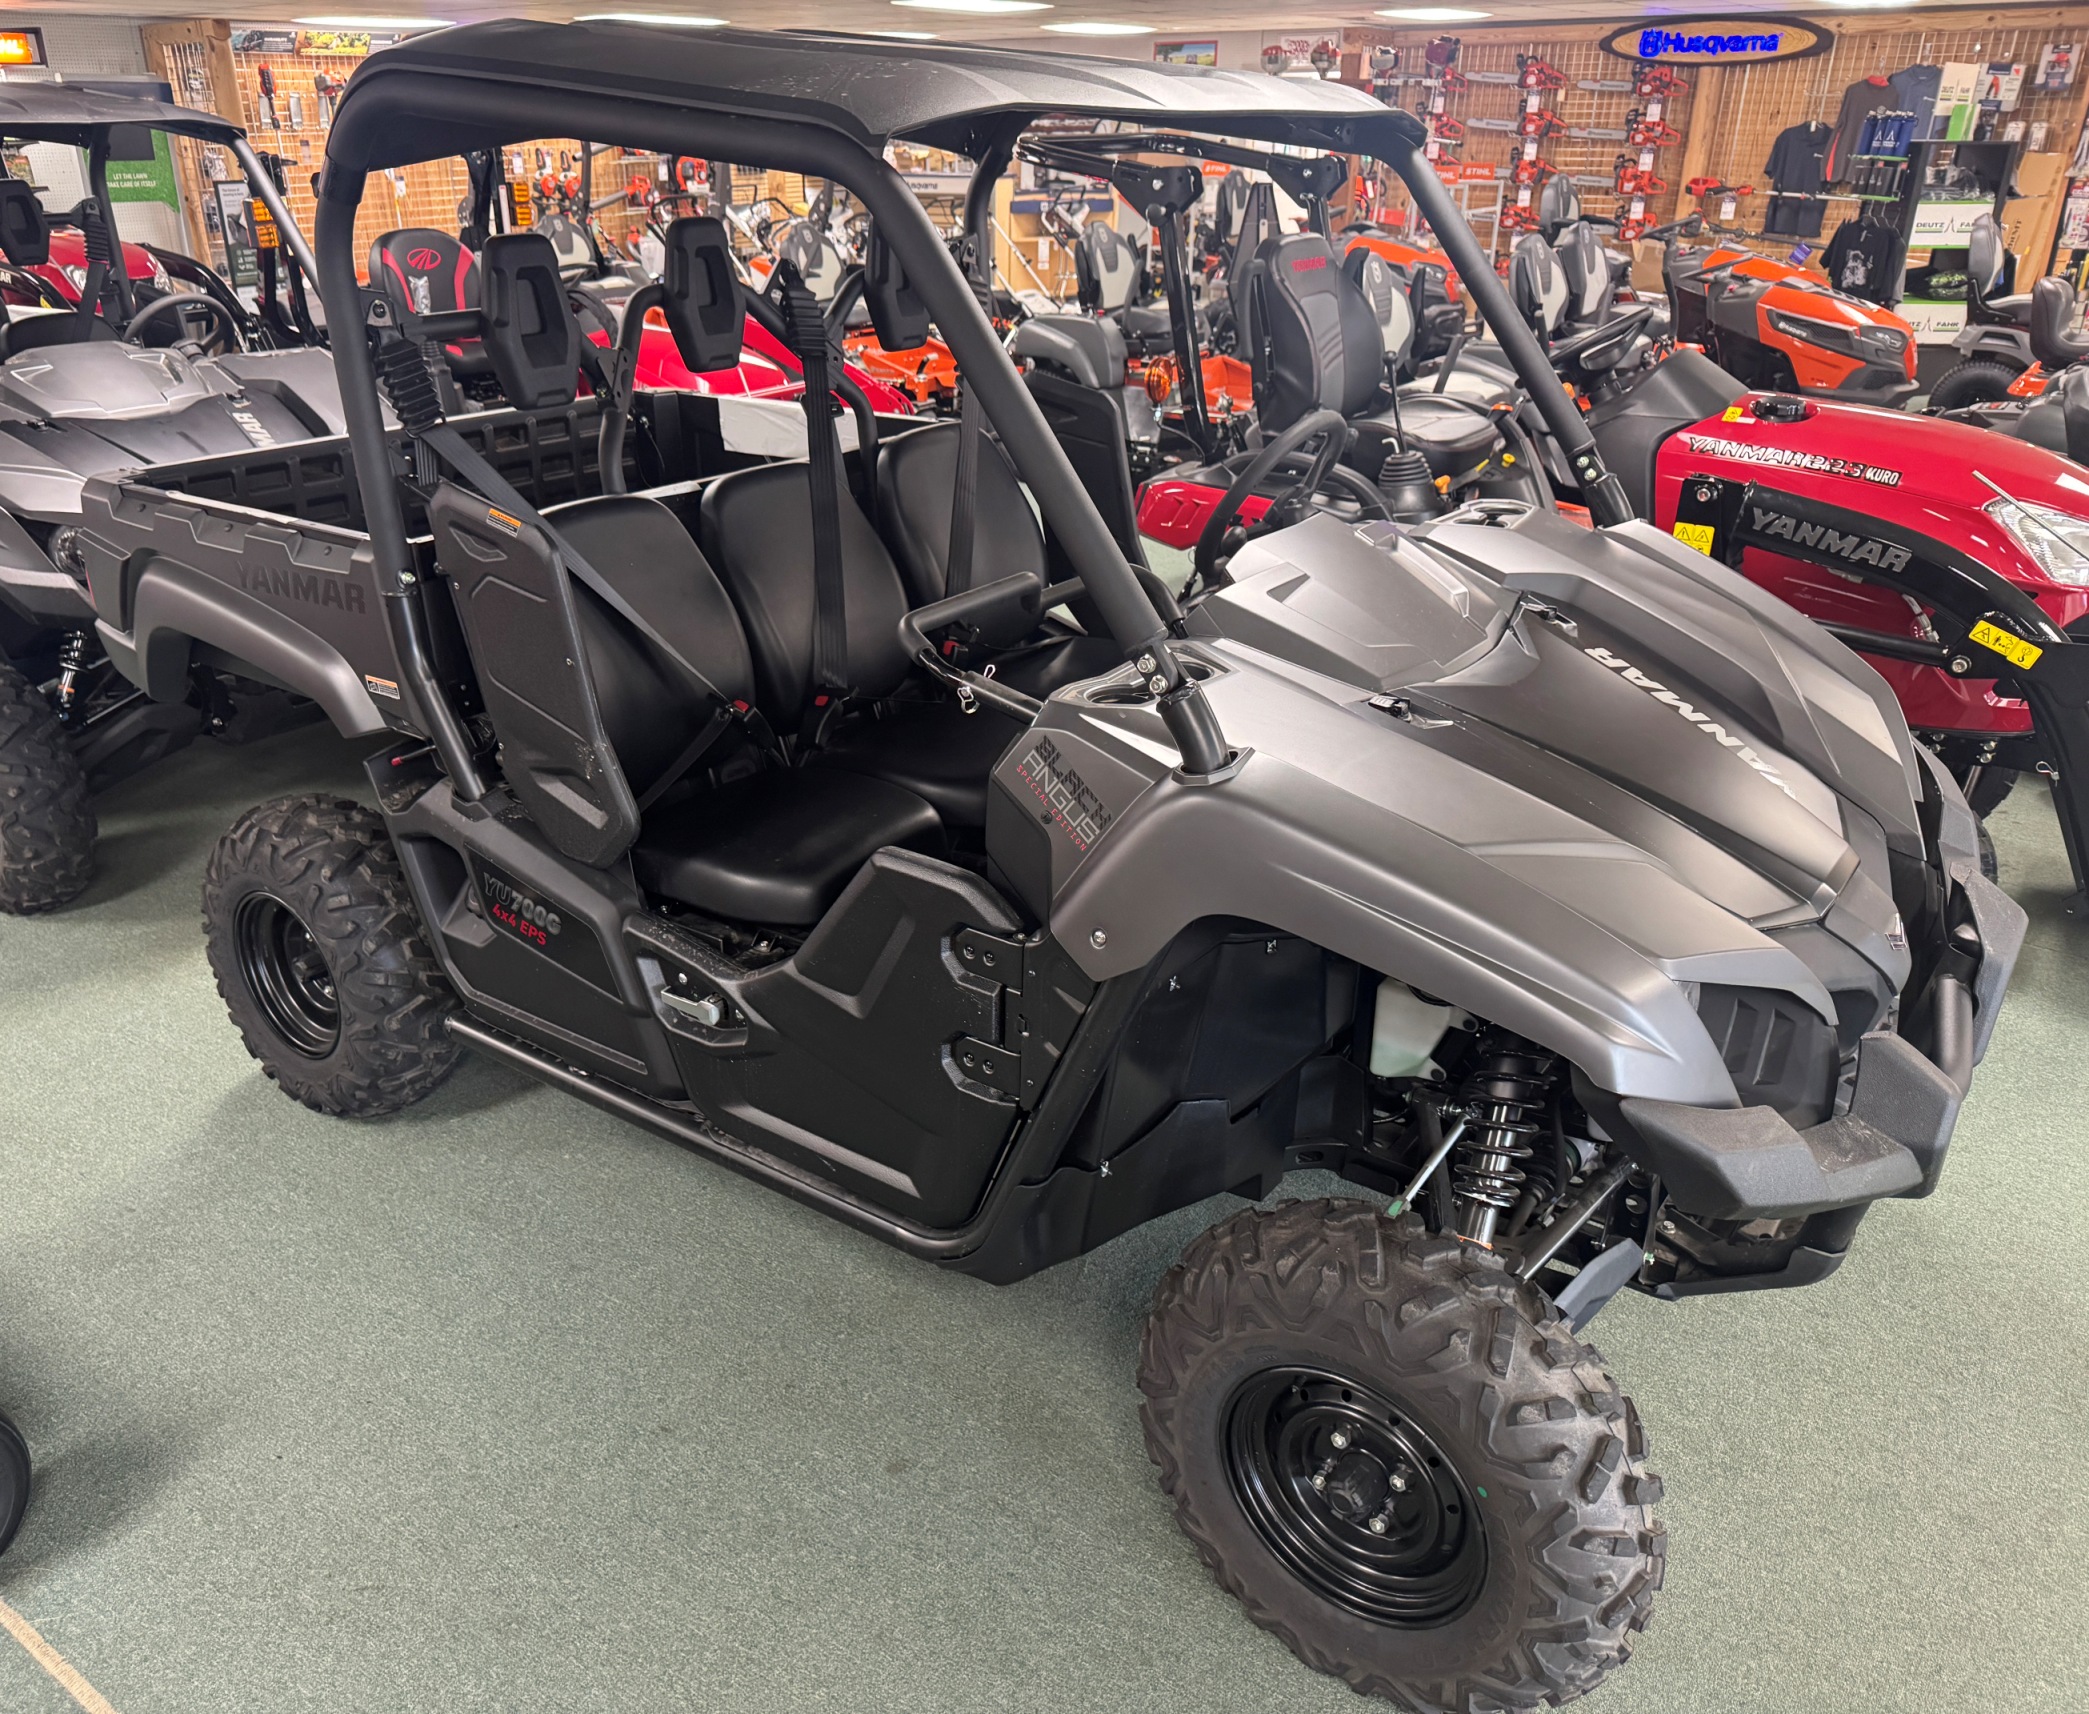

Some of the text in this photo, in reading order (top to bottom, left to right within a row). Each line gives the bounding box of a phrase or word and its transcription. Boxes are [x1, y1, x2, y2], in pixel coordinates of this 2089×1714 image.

[1663, 32, 1779, 56] Husqvarna
[1436, 171, 1456, 179] TIHL
[1465, 167, 1492, 176] STIHL
[232, 412, 275, 447] MAR
[1689, 436, 1806, 468] YANMAR
[1865, 466, 1901, 486] KURO
[1752, 506, 1912, 572] YANMAR
[236, 561, 366, 614] YANMAR
[1584, 647, 1797, 799] YANMAR
[1016, 764, 1087, 851] SPECIAL EDITION
[1023, 749, 1100, 844] ANGUS
[1034, 735, 1112, 831] BLACK
[483, 871, 562, 936] YU700G
[492, 903, 548, 946] 4x4 EPS
